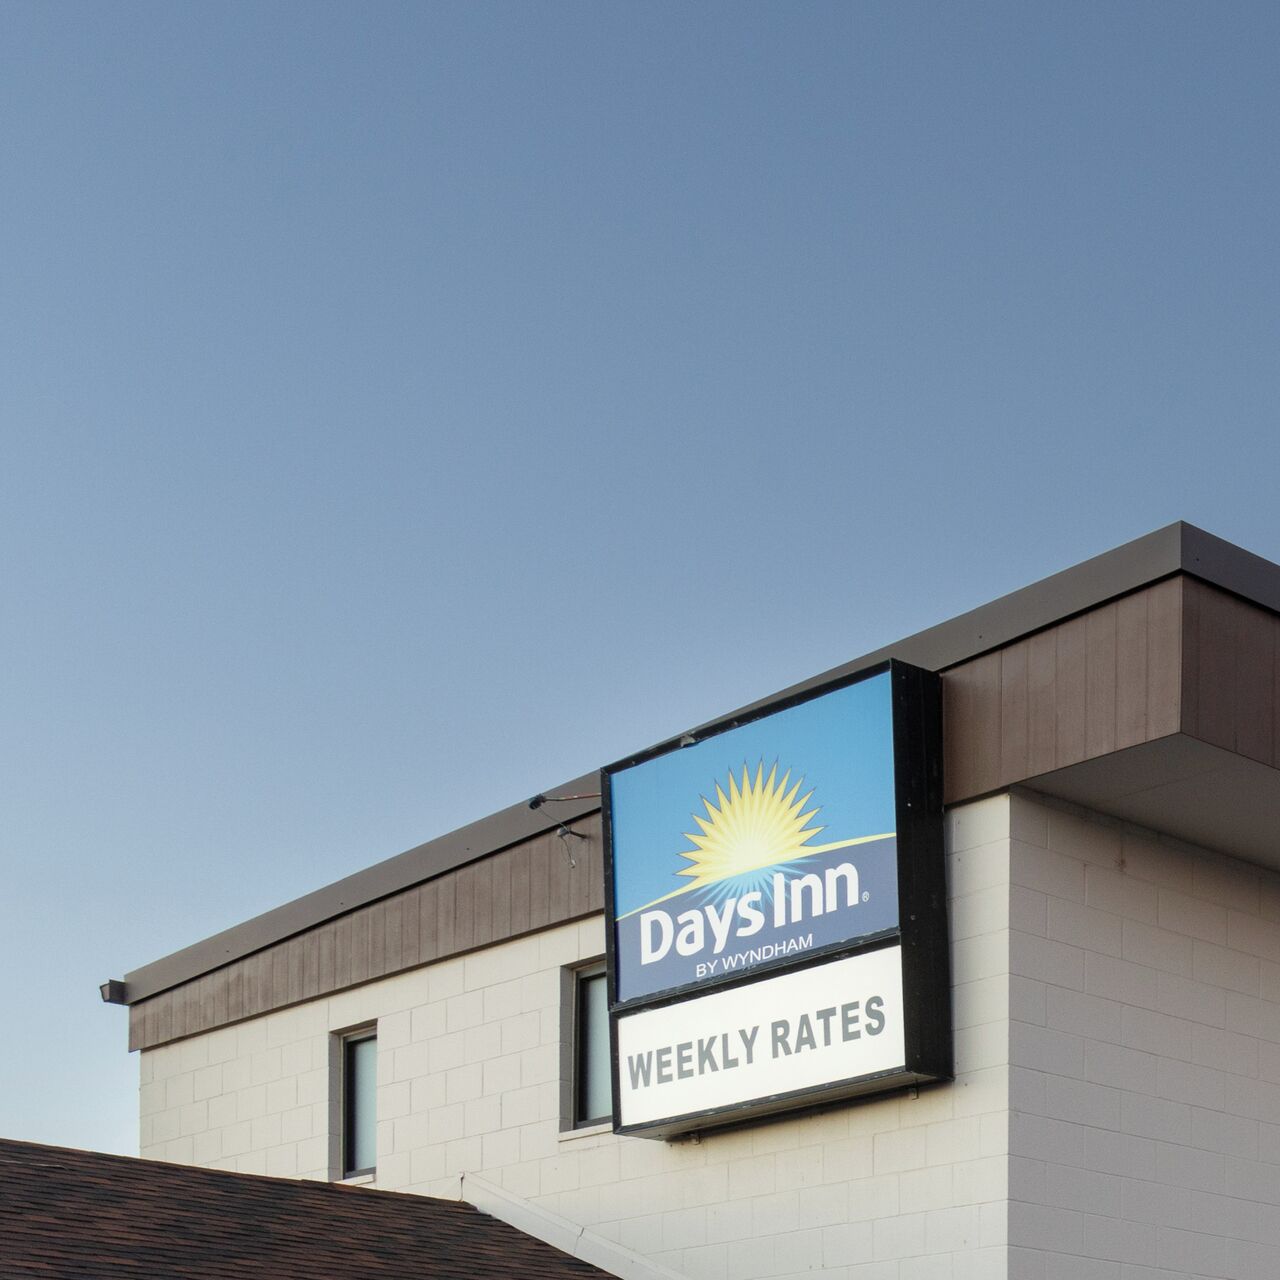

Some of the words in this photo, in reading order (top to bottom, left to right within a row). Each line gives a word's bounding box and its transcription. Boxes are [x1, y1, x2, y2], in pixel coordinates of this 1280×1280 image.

[640, 891, 765, 966] Days
[773, 862, 859, 929] Inn
[696, 960, 718, 978] BY
[723, 933, 813, 970] WYNDHAM
[628, 1025, 760, 1090] WEEKLY
[771, 995, 886, 1059] RATES
